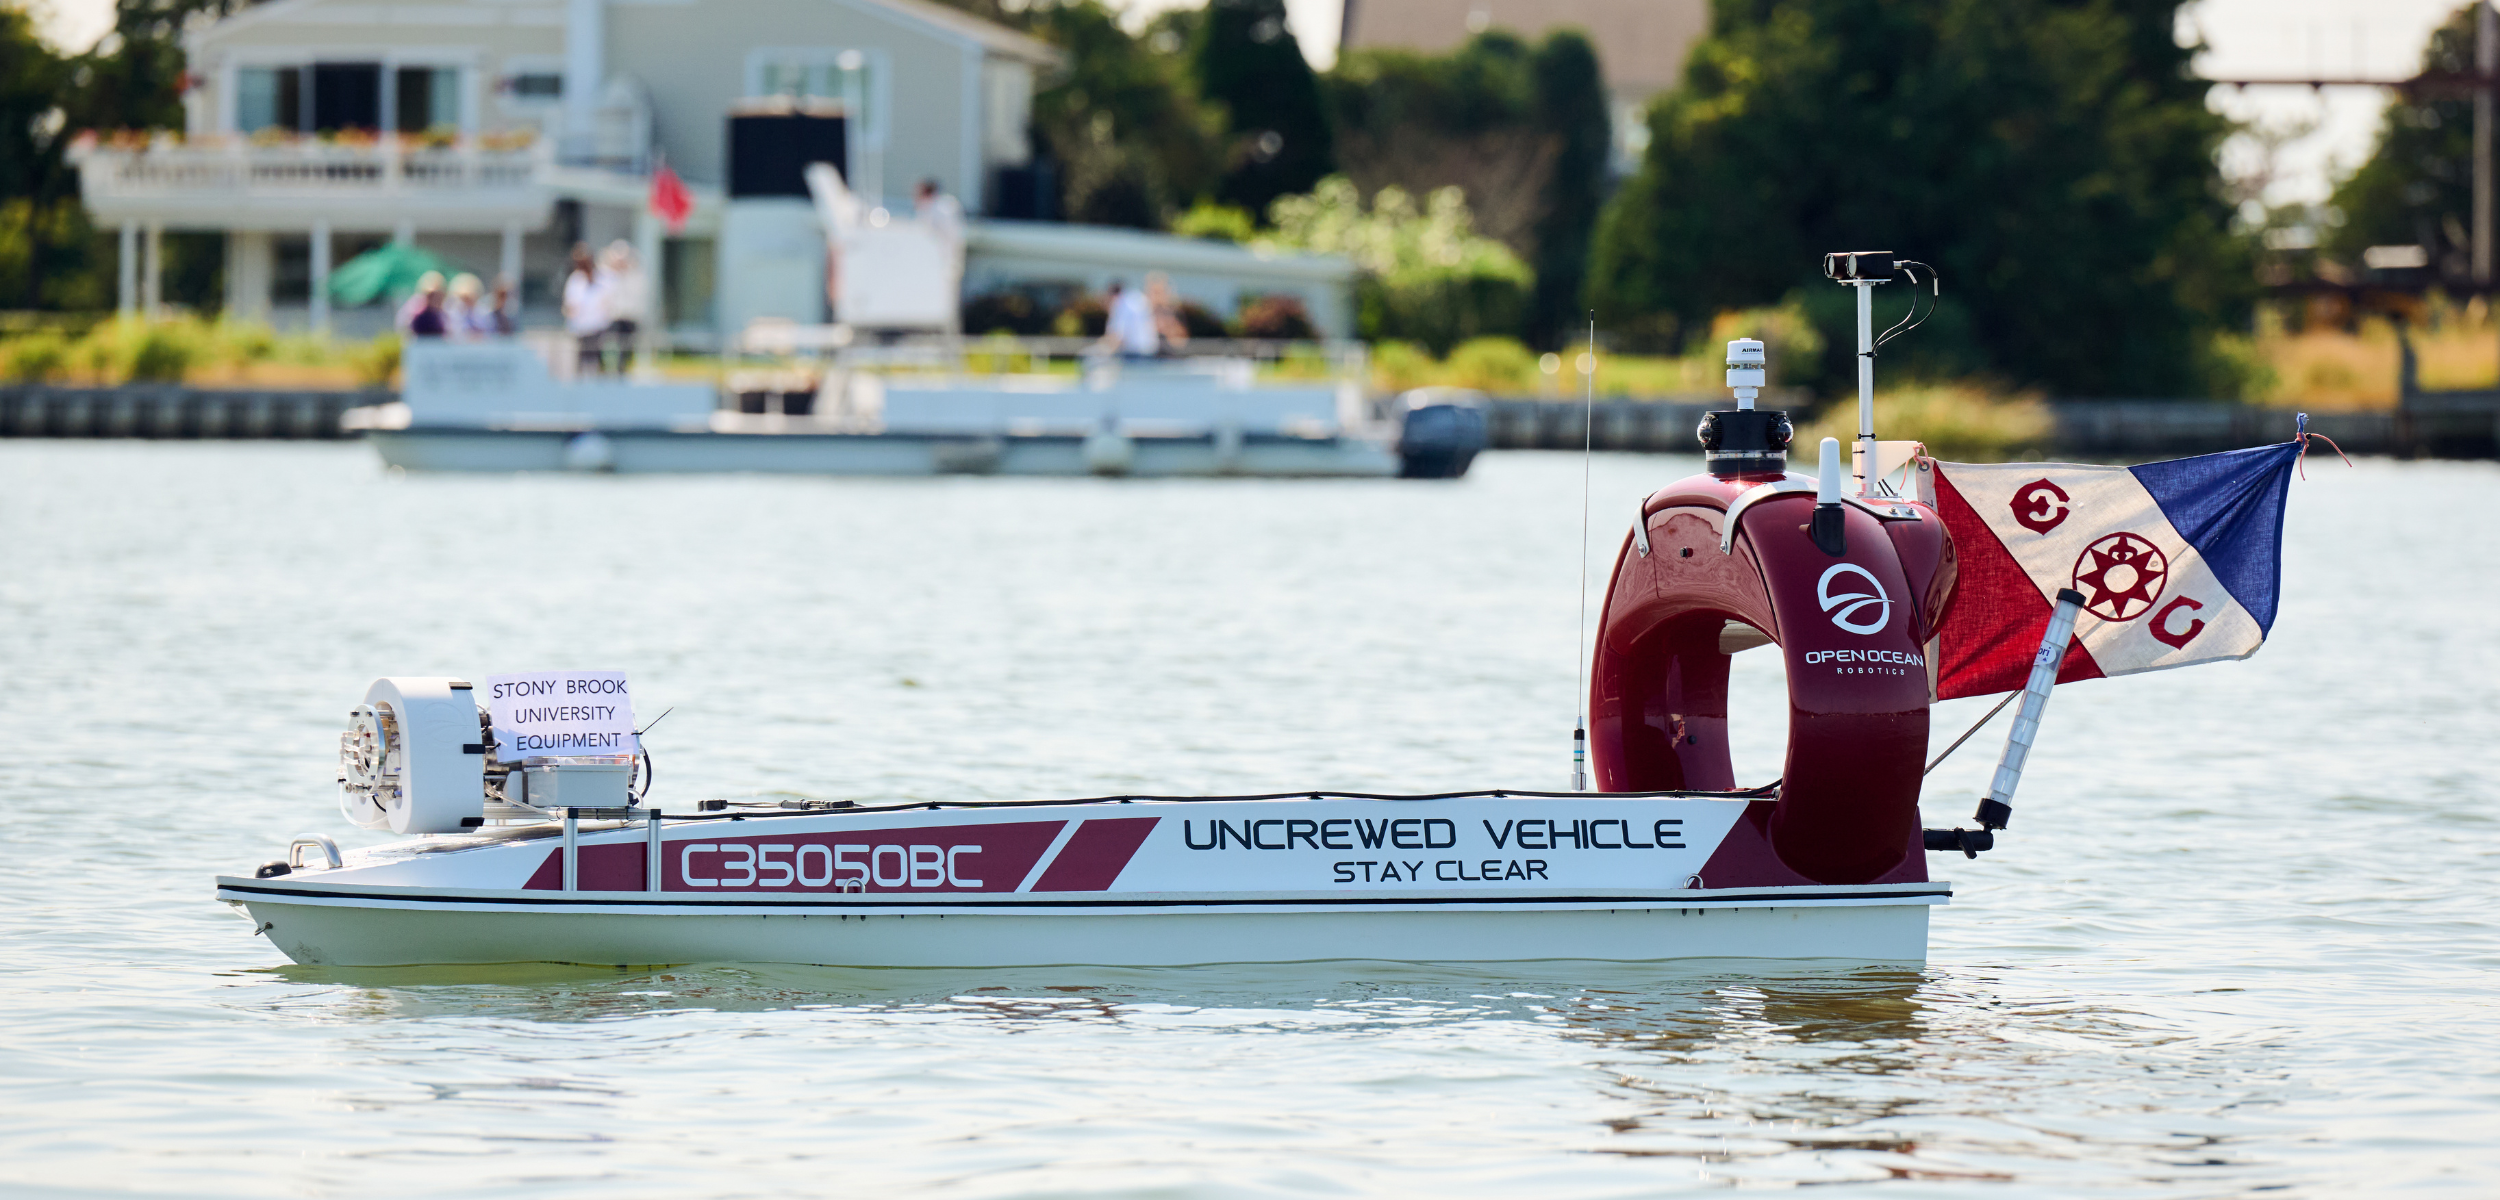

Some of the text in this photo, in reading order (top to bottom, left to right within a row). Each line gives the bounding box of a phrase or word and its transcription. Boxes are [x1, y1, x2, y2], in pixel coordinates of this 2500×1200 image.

[1837, 667, 1905, 676] ROBOTICS
[493, 679, 627, 699] STONY BROOK
[515, 706, 616, 724] UNIVERSITY
[516, 732, 621, 751] EQUIPMENT
[1184, 819, 1686, 851] UNCREWED VEHICLE
[681, 843, 984, 888] C35050BC
[1333, 859, 1549, 883] STAY CLEAR
